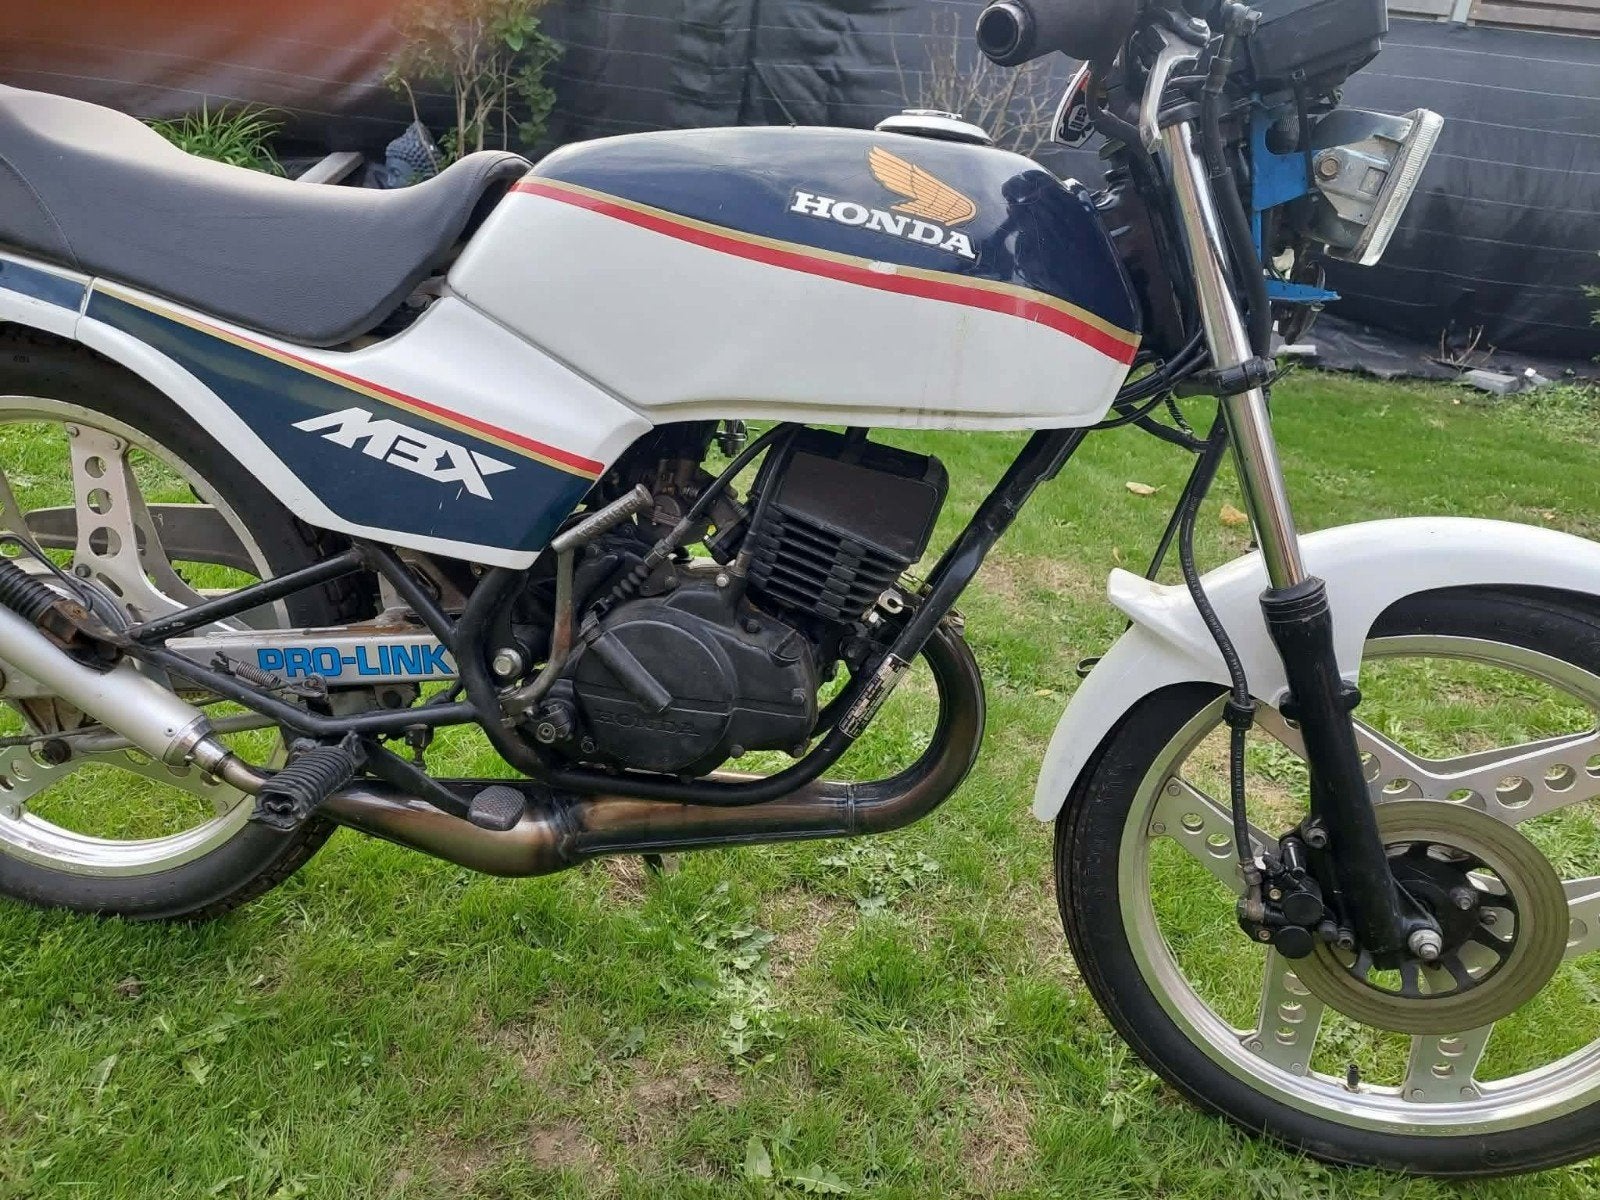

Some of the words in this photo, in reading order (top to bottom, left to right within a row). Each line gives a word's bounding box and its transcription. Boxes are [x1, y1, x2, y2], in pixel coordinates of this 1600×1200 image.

[790, 191, 976, 259] HONDA
[291, 407, 517, 501] MBX
[257, 644, 454, 678] PRO-LINK
